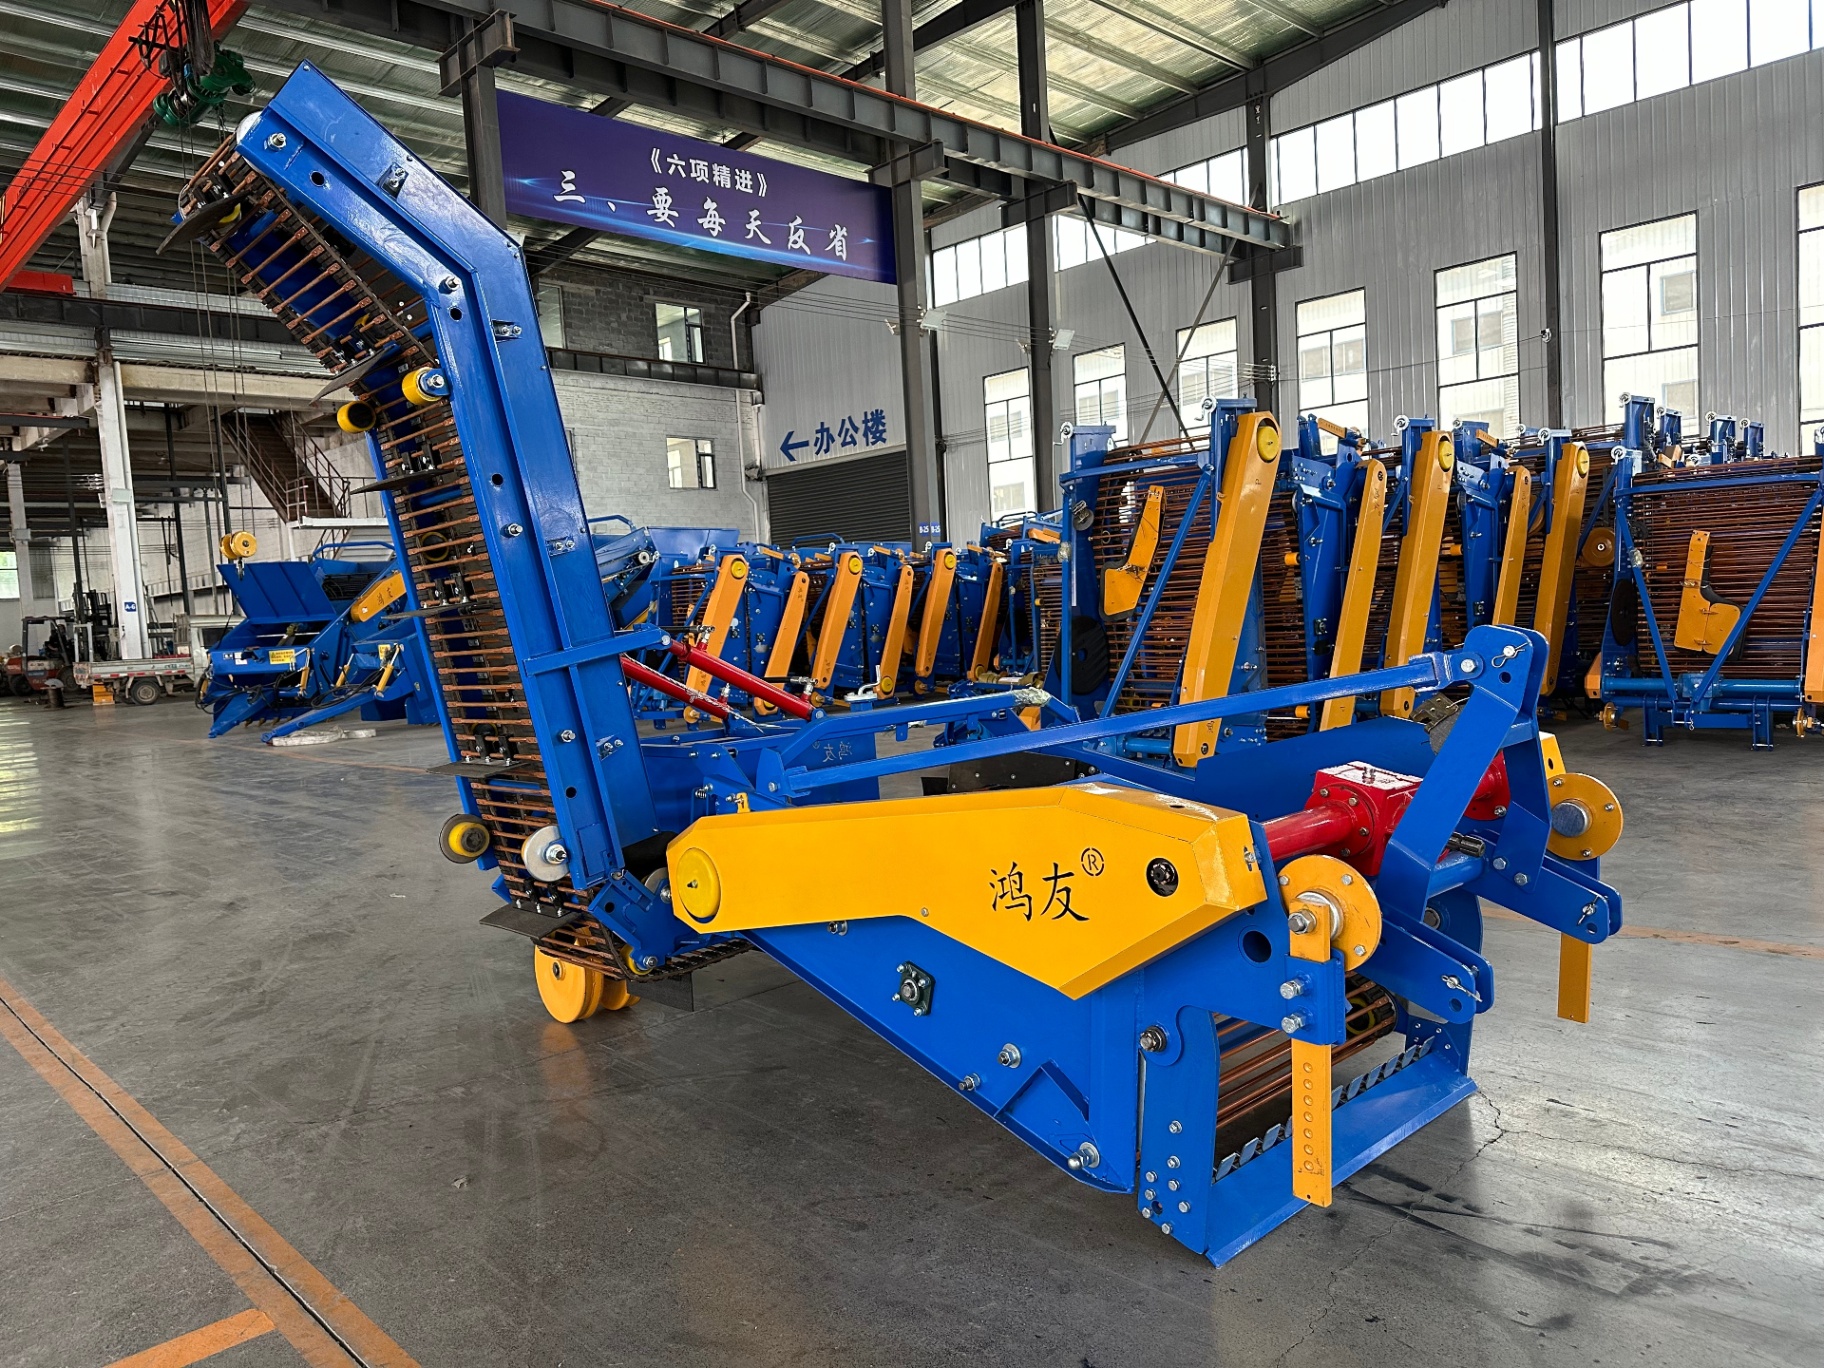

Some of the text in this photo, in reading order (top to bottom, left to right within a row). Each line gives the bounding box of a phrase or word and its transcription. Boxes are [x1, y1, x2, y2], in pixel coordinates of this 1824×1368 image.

[651, 147, 767, 198] 《六项精进》
[553, 170, 849, 261] 三、要每天反省
[813, 408, 887, 456] 办公楼
